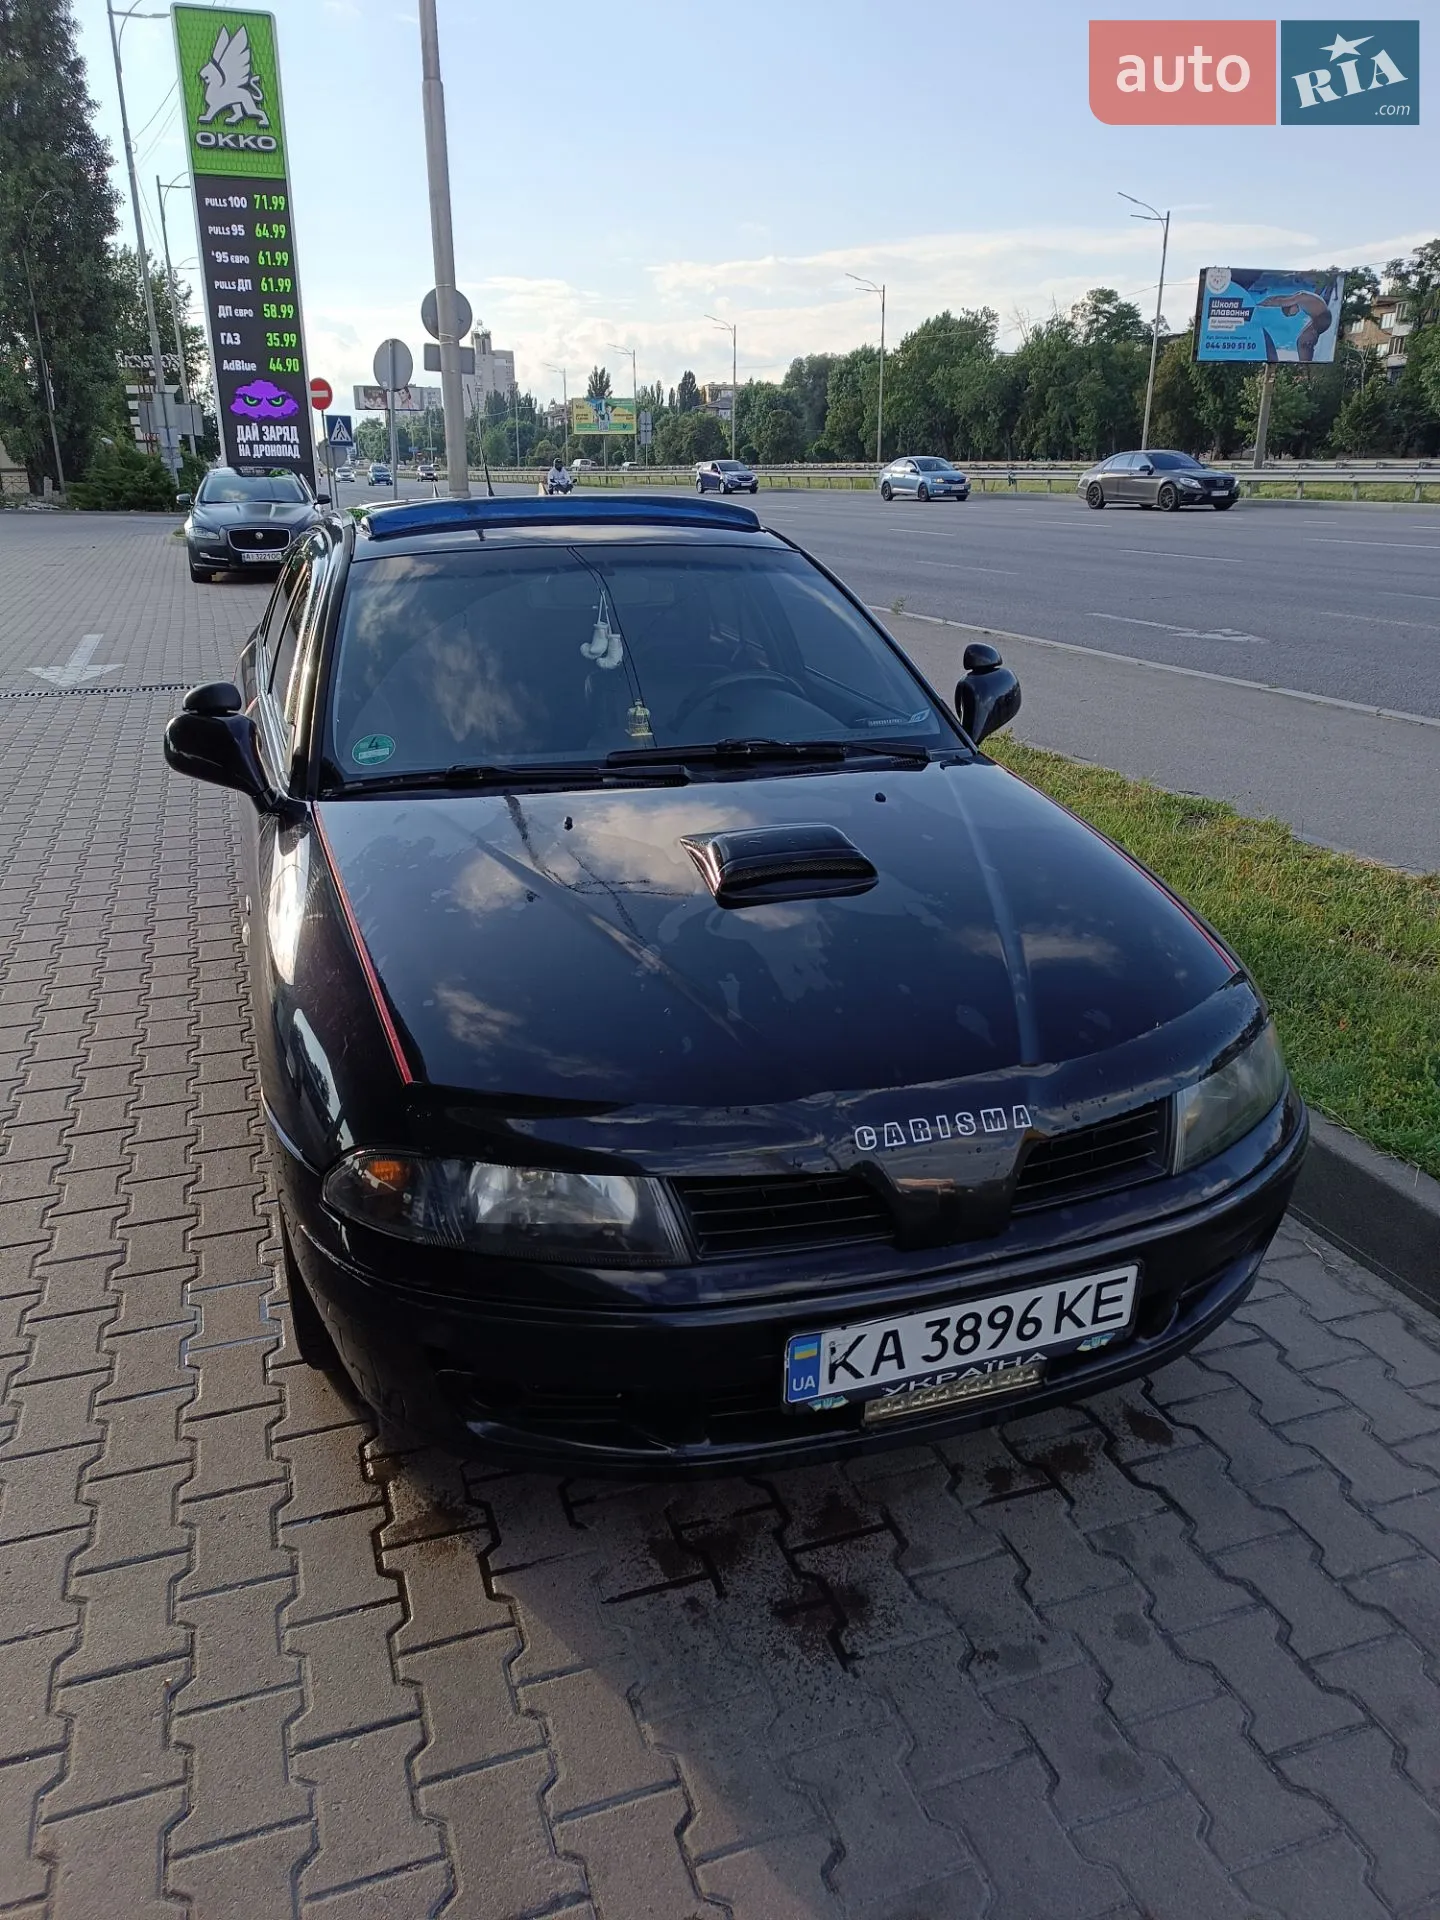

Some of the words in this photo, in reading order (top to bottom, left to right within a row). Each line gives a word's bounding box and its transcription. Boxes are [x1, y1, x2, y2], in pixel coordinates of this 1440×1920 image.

[195, 132, 278, 150] OKKO
[205, 197, 228, 208] PULLS
[228, 196, 248, 209] 100
[253, 194, 286, 211] 71.99
[208, 225, 230, 236] PULLS
[231, 224, 245, 236] 95
[255, 223, 286, 239] 64.99
[258, 250, 289, 266] 61.99
[214, 280, 237, 290] PULLS
[237, 279, 252, 292] ДП
[260, 277, 291, 293] 61.99
[218, 305, 233, 319] ДП
[263, 303, 294, 319] 58.99
[1211, 300, 1239, 308] Школа
[1210, 309, 1250, 317] плавання
[220, 332, 241, 345] ГАЗ
[266, 332, 297, 348] 35.99
[1205, 342, 1220, 350] 044
[222, 359, 257, 372] AdBlue
[269, 357, 300, 373] 44.90
[236, 423, 260, 443] ДАЙ
[263, 425, 300, 444] ЗАРЯД
[239, 444, 251, 457] НА
[253, 444, 301, 459] ДРОНОПАД
[368, 736, 380, 749] 4
[854, 1104, 1032, 1150] CARISMA
[827, 1328, 906, 1385] KA
[920, 1296, 1043, 1363] 3896
[1053, 1276, 1130, 1335] KE
[881, 1351, 1048, 1397] УКРАЇНА
[792, 1375, 816, 1392] UA
